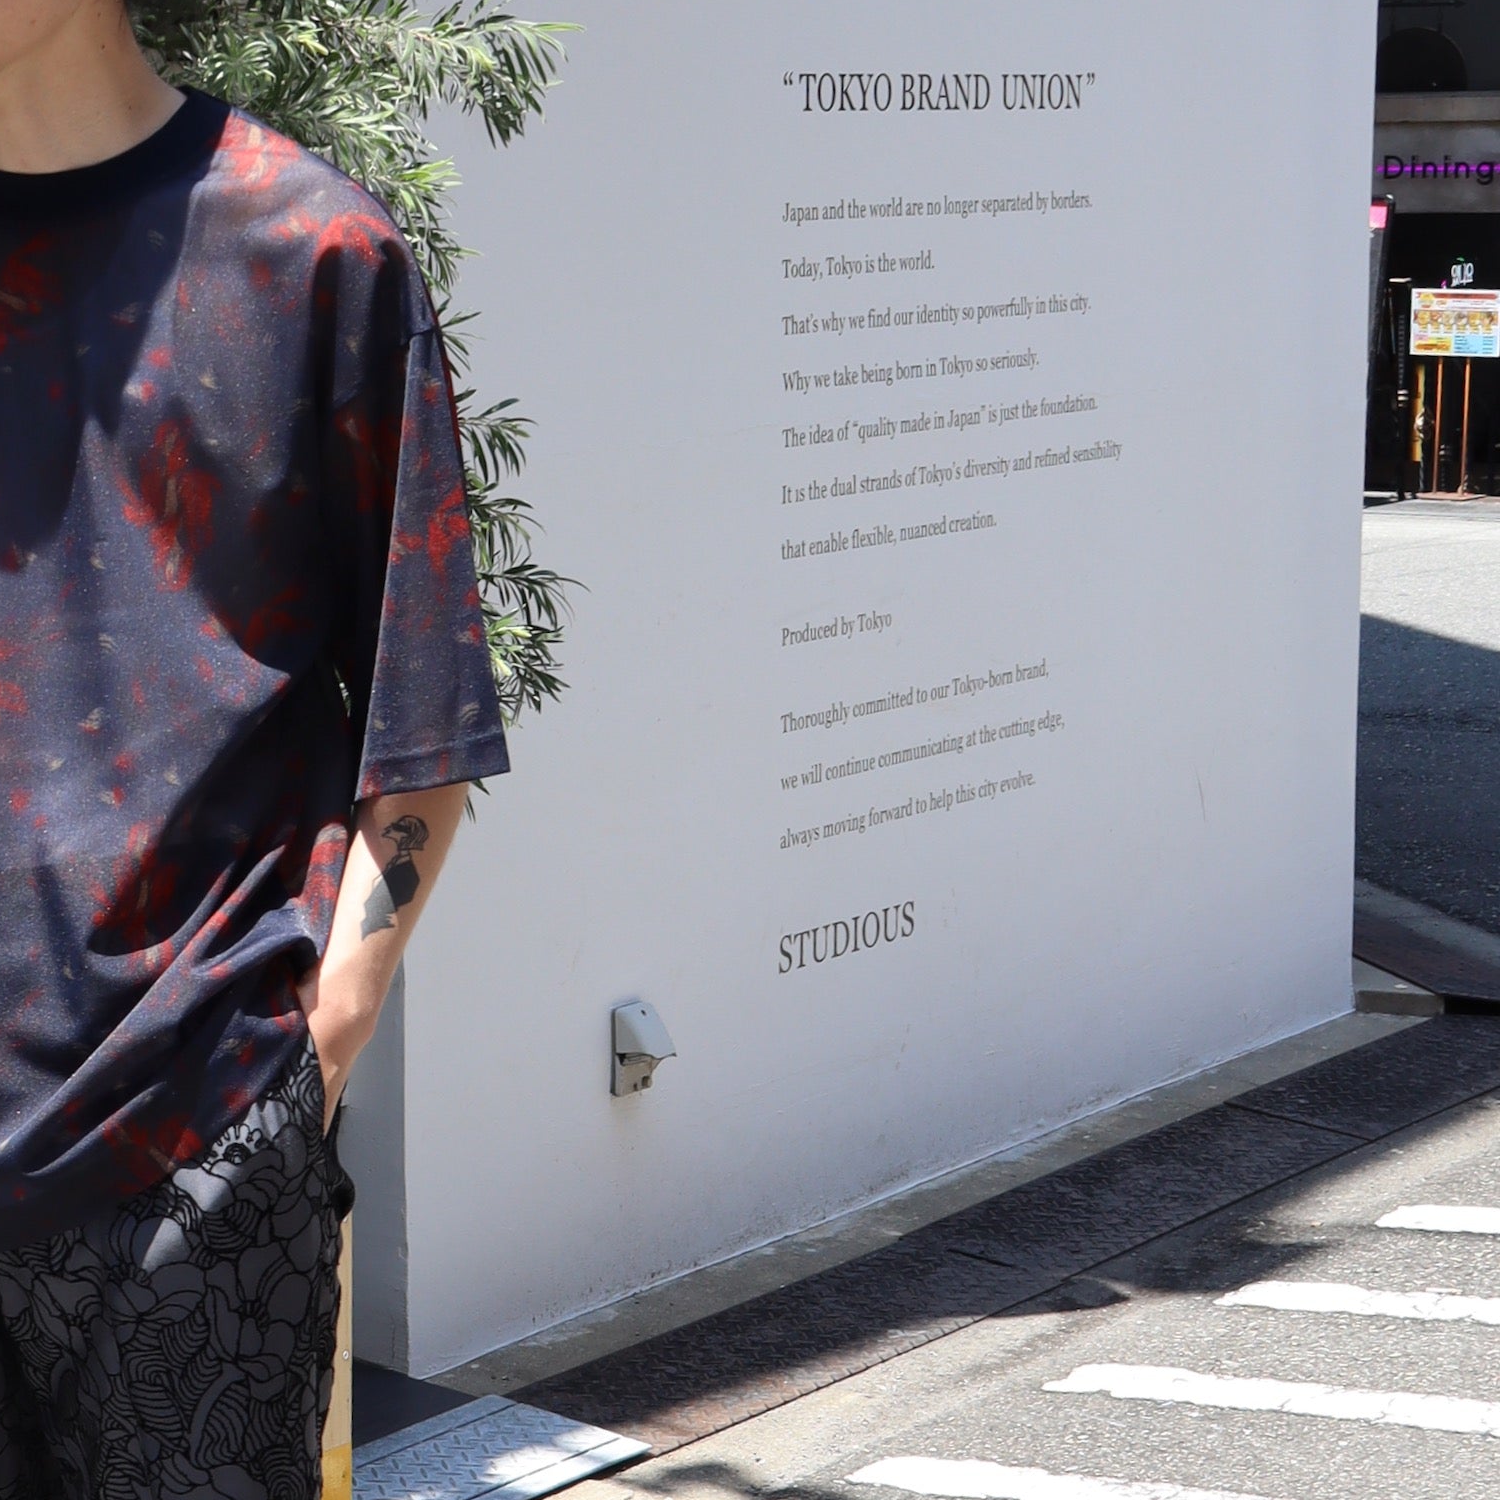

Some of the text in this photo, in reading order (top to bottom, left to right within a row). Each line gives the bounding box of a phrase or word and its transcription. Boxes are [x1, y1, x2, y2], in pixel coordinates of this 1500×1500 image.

[900, 73, 991, 111] BRAND
[1001, 71, 1096, 111] UNION”
[1384, 154, 1494, 186] Dining
[782, 190, 1092, 226] Japan and the world are no longer separated by borders.
[782, 250, 935, 281] Today, Tokyo is the world.
[821, 311, 845, 336] why
[849, 316, 865, 329] we
[868, 307, 890, 328] find
[894, 312, 914, 325] our
[917, 303, 959, 325] identity
[962, 307, 974, 320] so
[977, 296, 1033, 324] powerfully
[1036, 296, 1046, 314] in
[1049, 295, 1067, 313] this
[1070, 293, 1091, 315] city.
[783, 348, 1039, 395] Why we take being born in Tokyo so seriously.
[782, 427, 806, 448] The
[809, 424, 834, 444] idea
[837, 420, 850, 441] of
[900, 412, 931, 433] made
[934, 411, 944, 429] in
[988, 405, 997, 423] is
[999, 404, 1019, 426] just
[1022, 400, 1037, 418] the
[1041, 394, 1097, 416] foundation.
[782, 485, 792, 504] It
[795, 488, 805, 502] is
[808, 480, 827, 500] the
[830, 475, 856, 497] dual
[860, 469, 902, 493] strands
[905, 466, 918, 486] of
[964, 456, 1010, 478] diversity
[1013, 451, 1031, 471] and
[1035, 446, 1070, 468] refined
[1073, 440, 1122, 463] sensibility
[782, 511, 996, 560] that enable flexible, nuanced creation.
[782, 611, 892, 646] Produced by Tokyo
[780, 658, 1048, 733] Thoroughly committed to our Tokyo-born brand,
[781, 710, 1064, 790] we will continue communicating at the cutting edge,
[780, 771, 1035, 849] always moving forward to help this city evolve.
[778, 900, 916, 975] STUDIOUS
